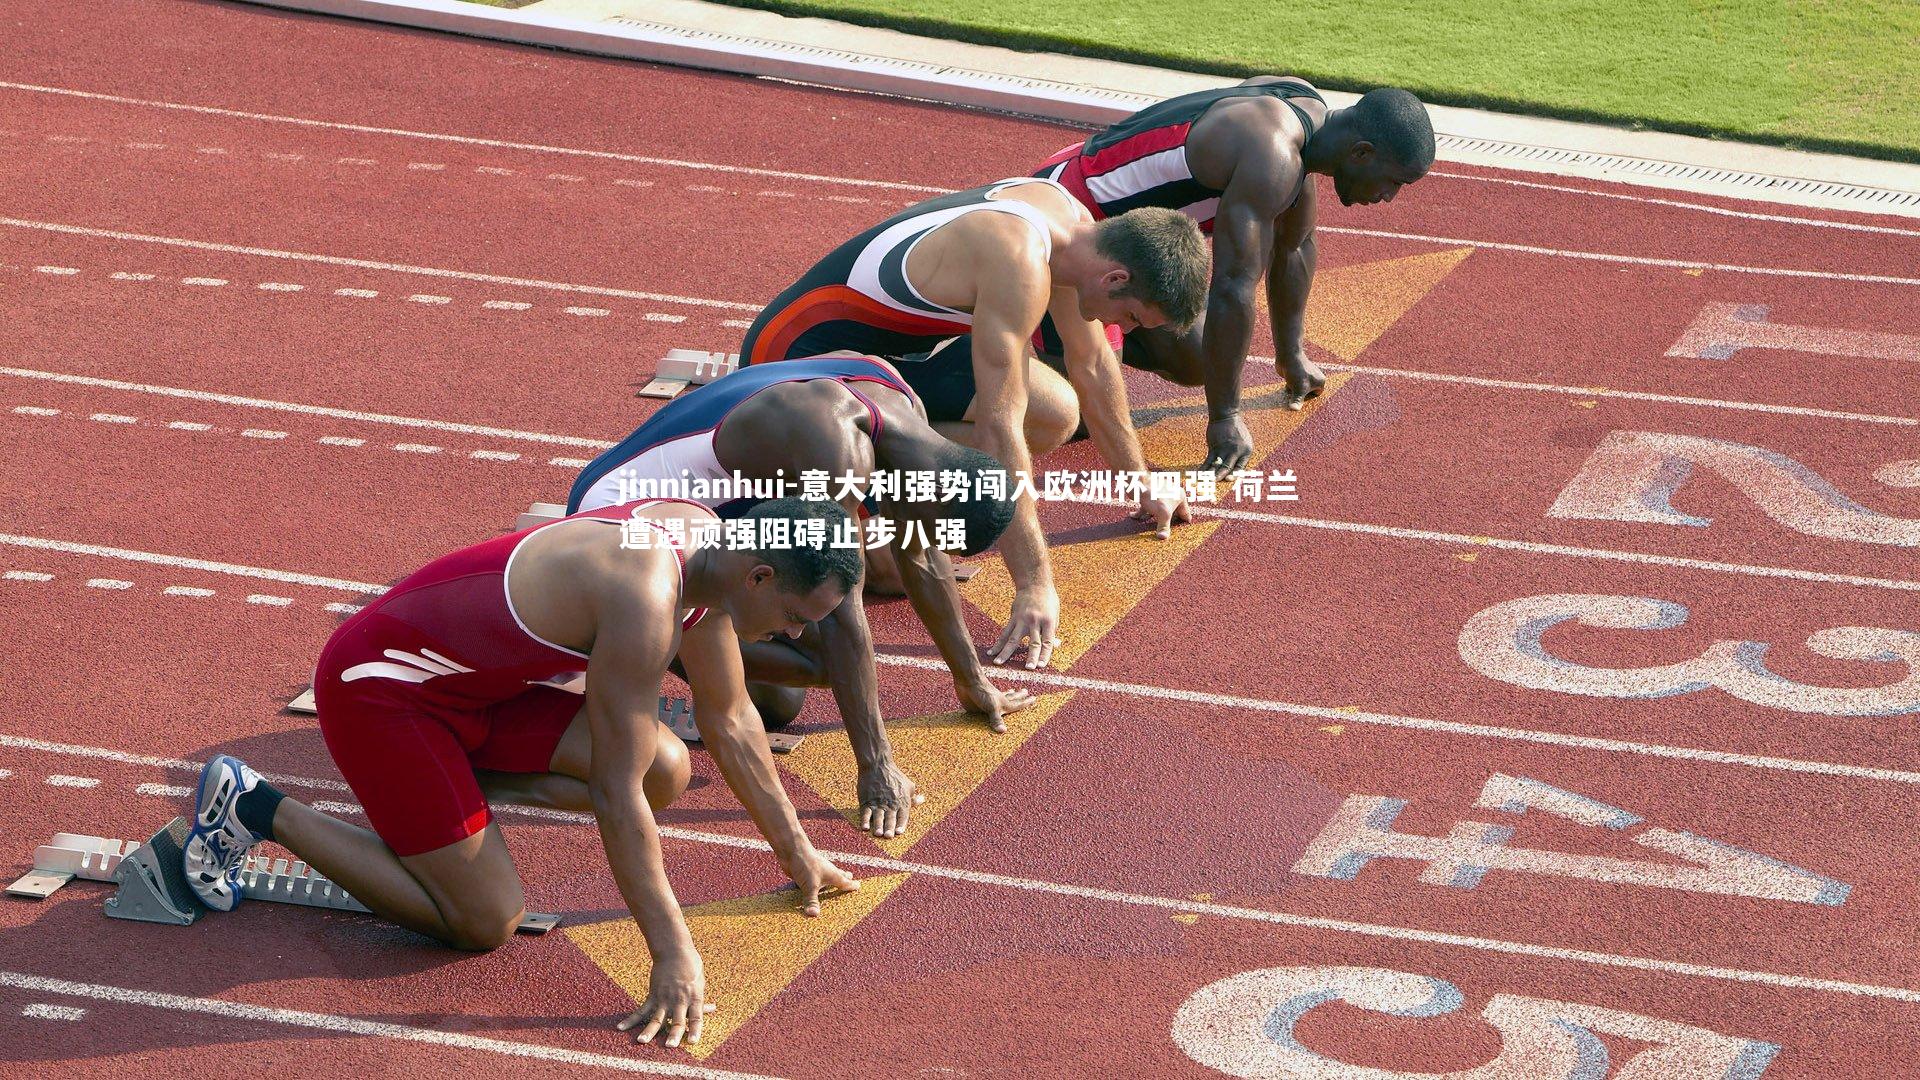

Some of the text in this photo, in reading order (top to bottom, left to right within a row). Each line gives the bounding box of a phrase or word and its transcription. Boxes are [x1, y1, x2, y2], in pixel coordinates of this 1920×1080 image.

[1547, 430, 1920, 547] 2
[1457, 594, 1920, 717] 3
[1290, 773, 1852, 906] 4
[1171, 966, 1780, 1080] 5
